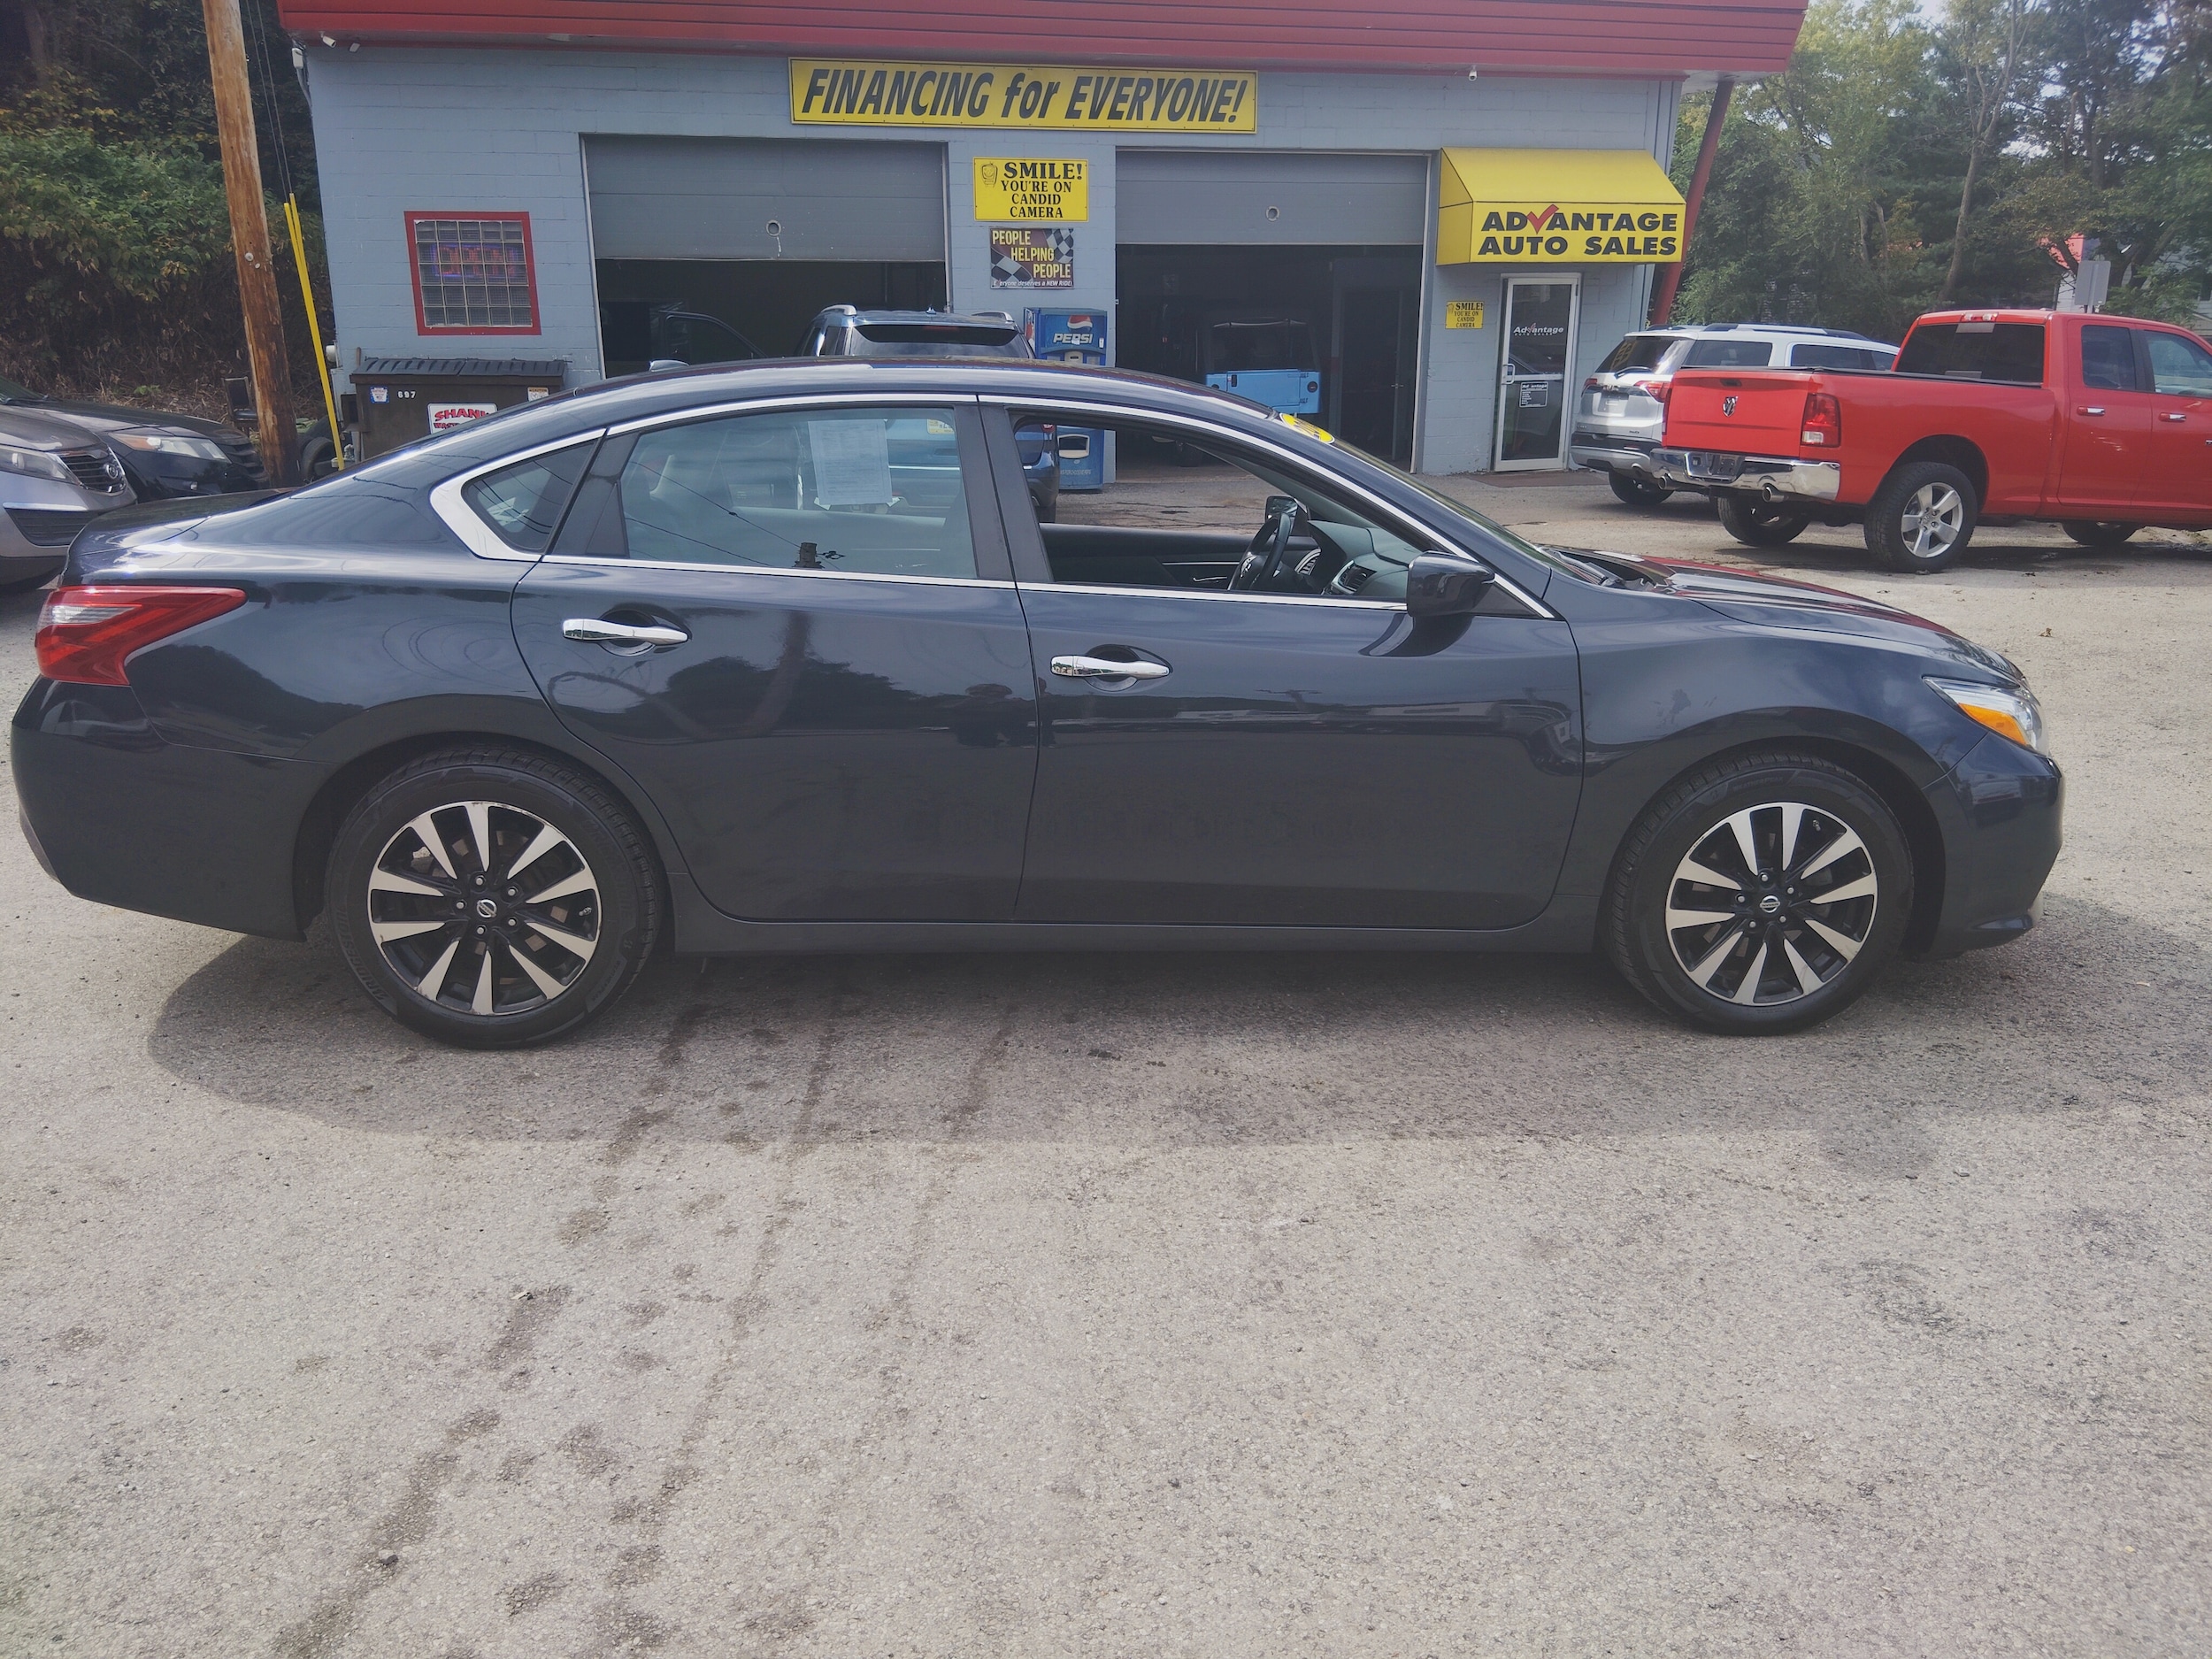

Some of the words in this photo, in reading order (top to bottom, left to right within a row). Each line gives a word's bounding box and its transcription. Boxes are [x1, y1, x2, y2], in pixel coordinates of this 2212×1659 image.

[802, 68, 995, 119] FINANCING
[1001, 73, 1061, 119] for
[1064, 76, 1248, 123] EVERYONE!
[1003, 162, 1082, 180] SMILE!
[1001, 180, 1048, 192] YOU'RE
[1054, 181, 1071, 193] ON
[1011, 193, 1061, 204] CANDID
[1010, 206, 1063, 218] CAMERA
[992, 230, 1031, 245] PEOPLE
[1478, 236, 1568, 256] AUTO
[1584, 236, 1677, 256] SALES
[1010, 247, 1055, 262] HELPING
[1033, 264, 1071, 279] PEOPLE
[1053, 333, 1094, 344] PEPSI
[397, 390, 416, 399] 697
